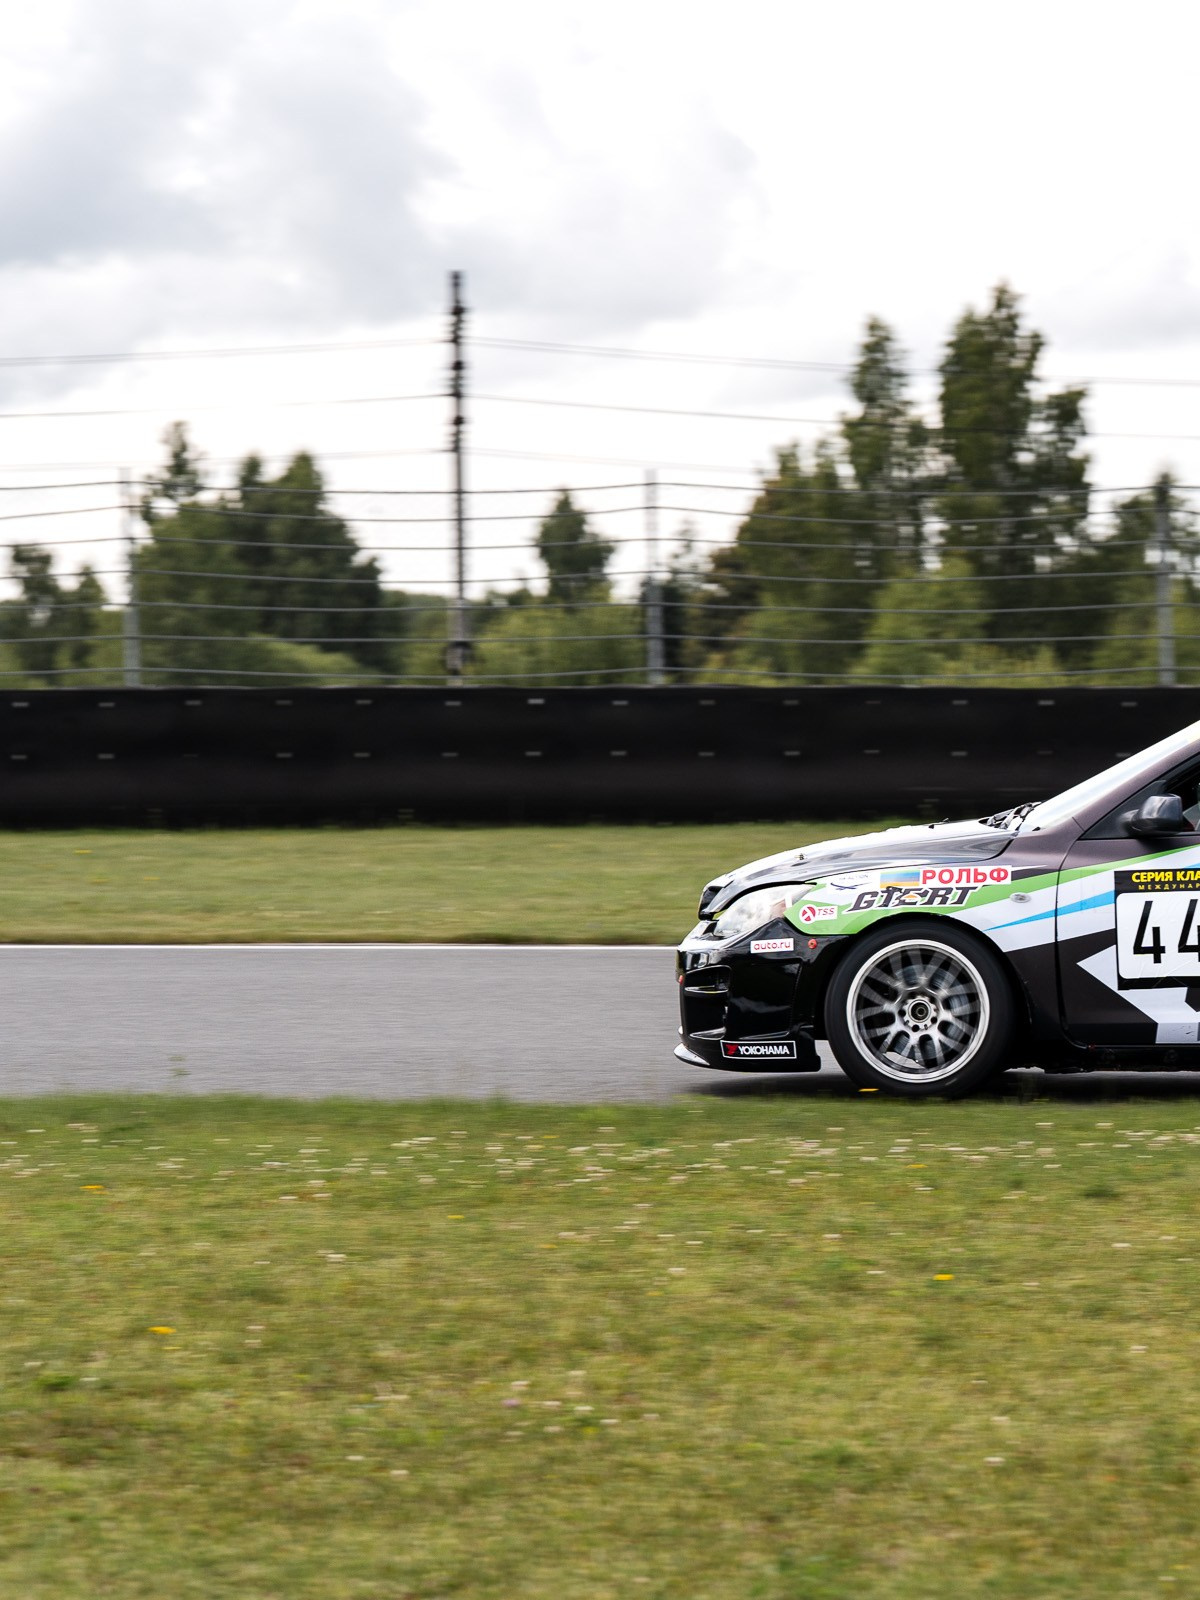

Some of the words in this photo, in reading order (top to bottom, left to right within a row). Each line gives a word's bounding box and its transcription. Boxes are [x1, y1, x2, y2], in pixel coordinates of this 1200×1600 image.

[922, 867, 1009, 885] РОЛЬФ
[1131, 871, 1173, 883] СЕРИЯ
[817, 907, 836, 916] TSS
[753, 940, 791, 951] auto.ru
[737, 1045, 790, 1055] YOKOHAMA
